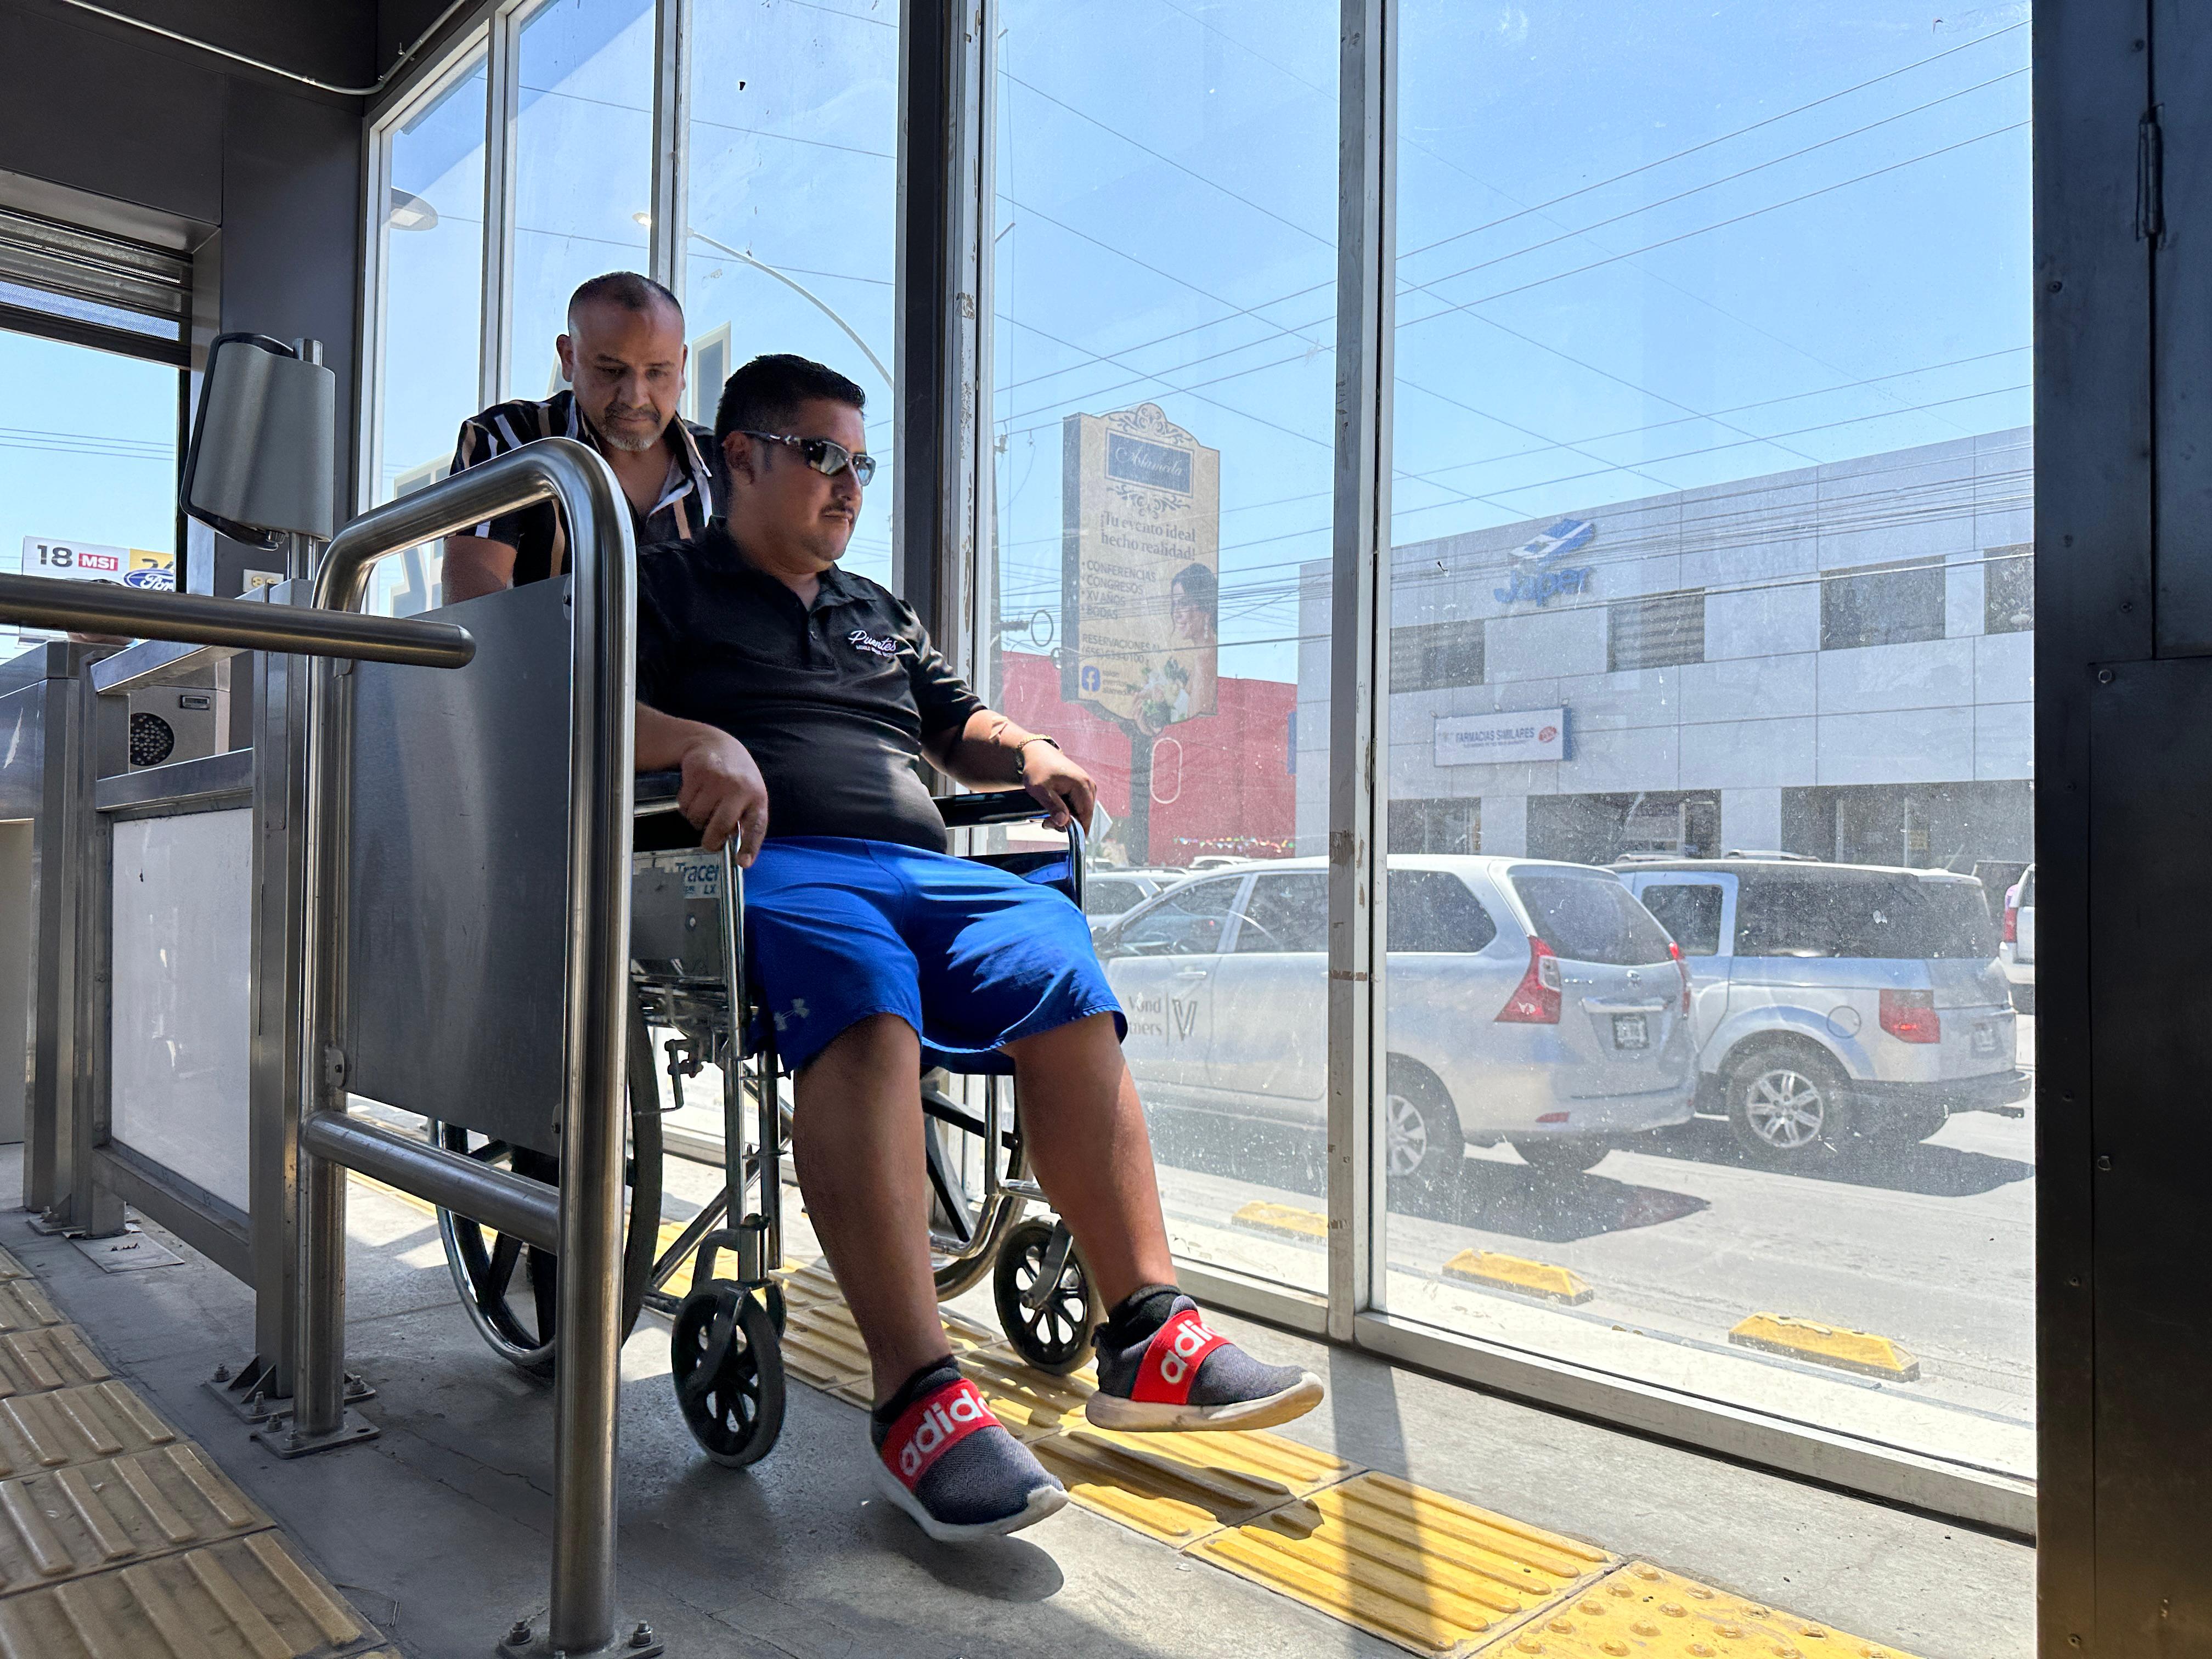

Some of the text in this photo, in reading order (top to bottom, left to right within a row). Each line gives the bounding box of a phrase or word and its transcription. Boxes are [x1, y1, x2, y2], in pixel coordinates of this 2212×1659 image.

[1122, 519, 1163, 536] evento
[1166, 523, 1195, 543] ideal
[1101, 530, 1195, 561] hecho realidad!
[37, 545, 115, 569] 18 MSI
[1087, 560, 1156, 583] CONFERENCIAS
[1087, 574, 1144, 595] CONGRESOS
[1087, 590, 1099, 601] XV
[1087, 605, 1118, 620] BODAS
[848, 630, 898, 652] Puentes
[1082, 633, 1151, 651] RESERVACIONES
[1455, 730, 1494, 742] FARMACIAS
[1496, 727, 1535, 740] SIMILARES
